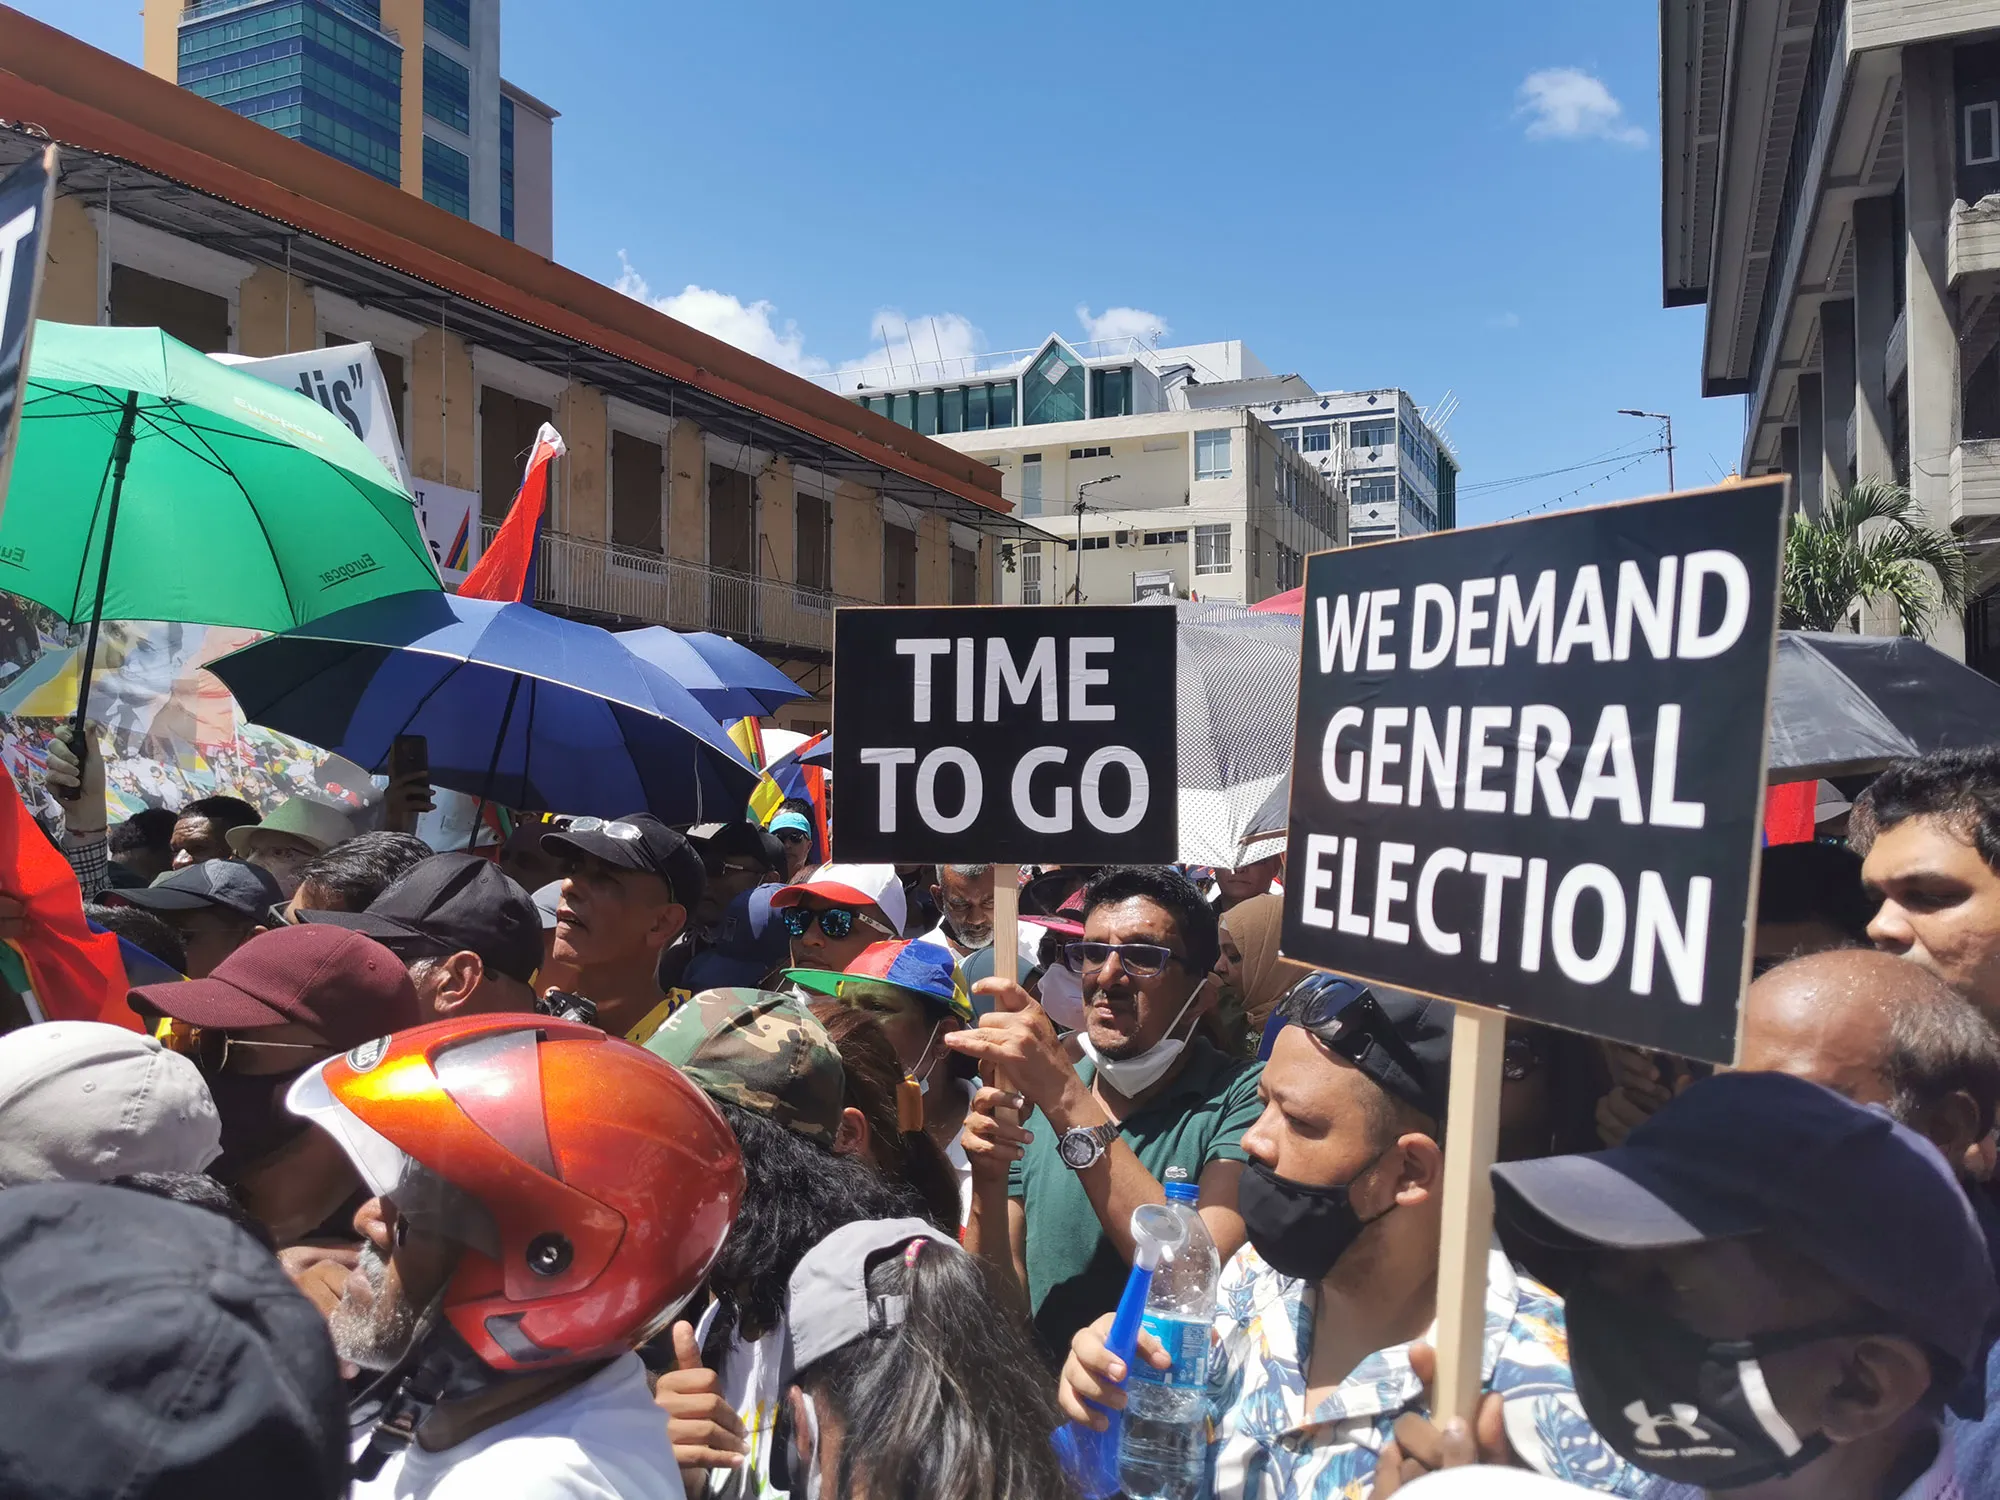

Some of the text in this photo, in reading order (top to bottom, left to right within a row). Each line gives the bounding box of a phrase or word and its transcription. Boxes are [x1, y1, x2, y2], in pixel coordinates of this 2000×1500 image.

[1316, 549, 1751, 674] WE DEMAND
[895, 636, 1116, 723] TIME
[860, 745, 1150, 834] TO GO
[1321, 703, 1706, 829] GENERAL
[1301, 833, 1713, 1007] ELECTION
